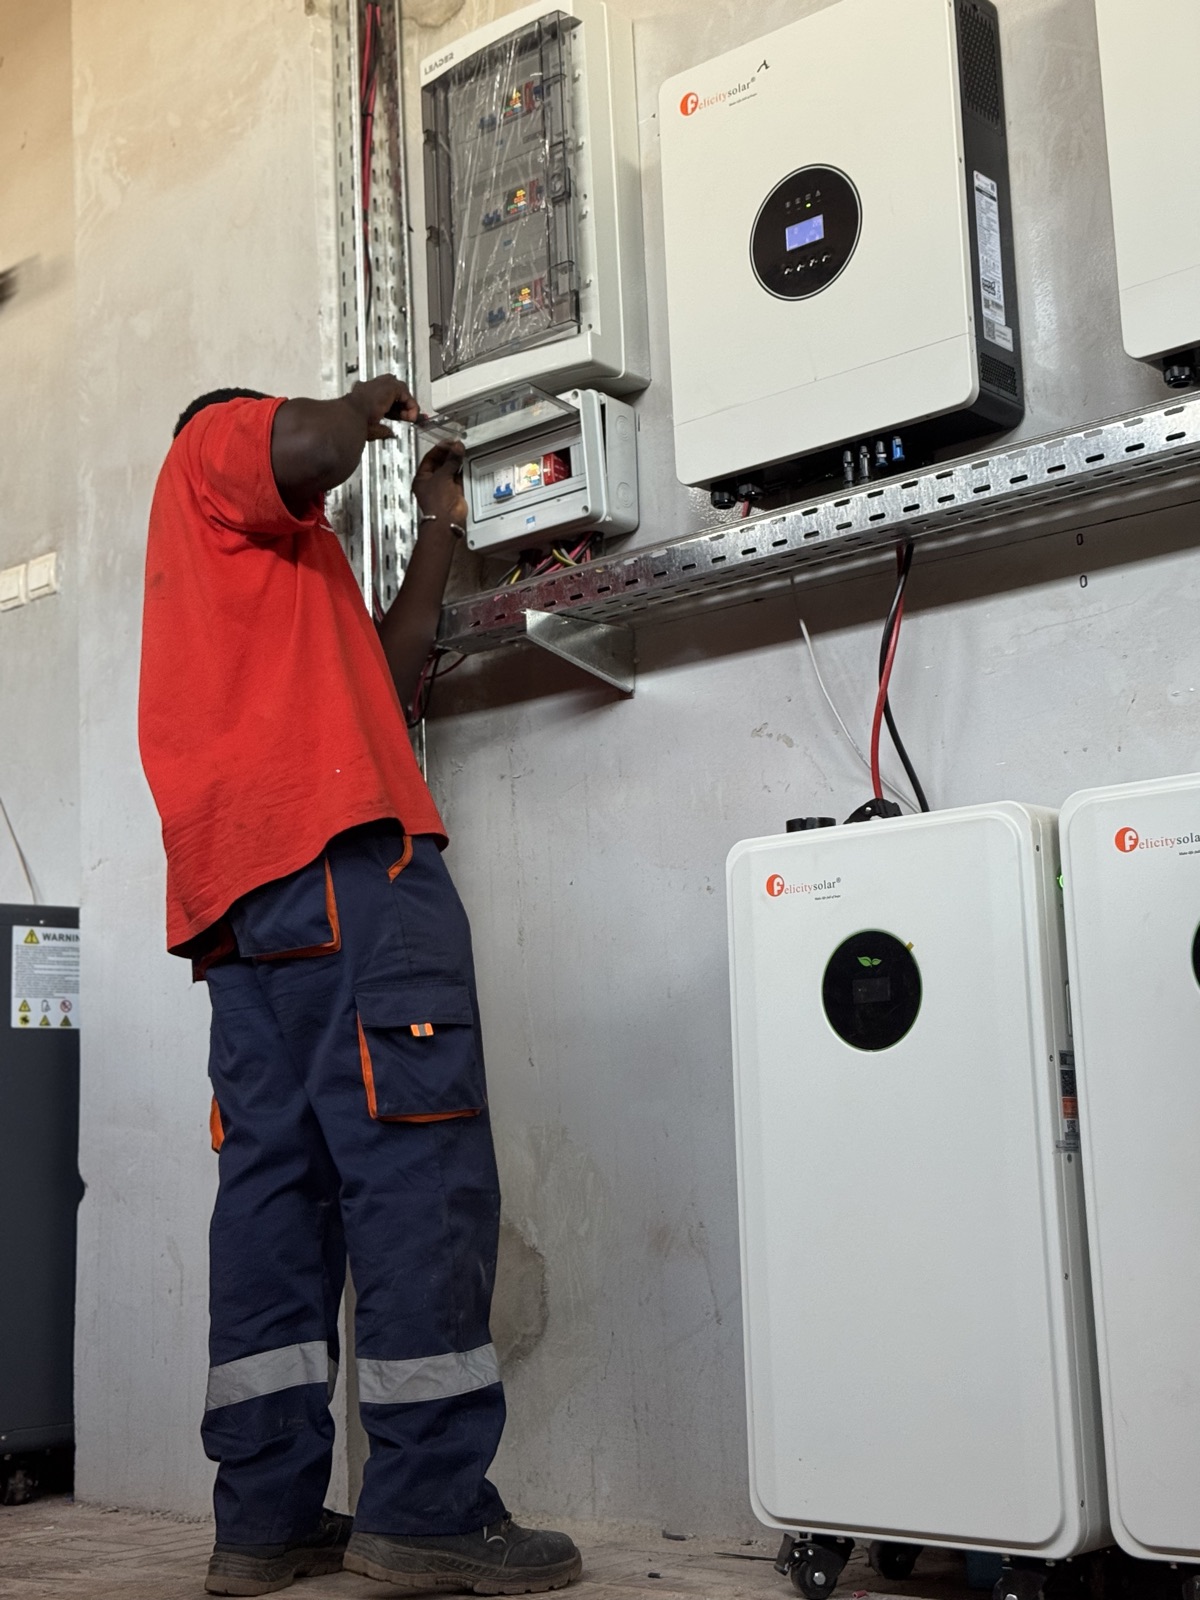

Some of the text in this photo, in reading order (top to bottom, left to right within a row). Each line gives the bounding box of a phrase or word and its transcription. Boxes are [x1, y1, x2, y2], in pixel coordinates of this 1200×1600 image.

[424, 52, 454, 76] LEADER
[1115, 827, 1200, 853] Felicitysola
[42, 933, 80, 942] WARNIN
